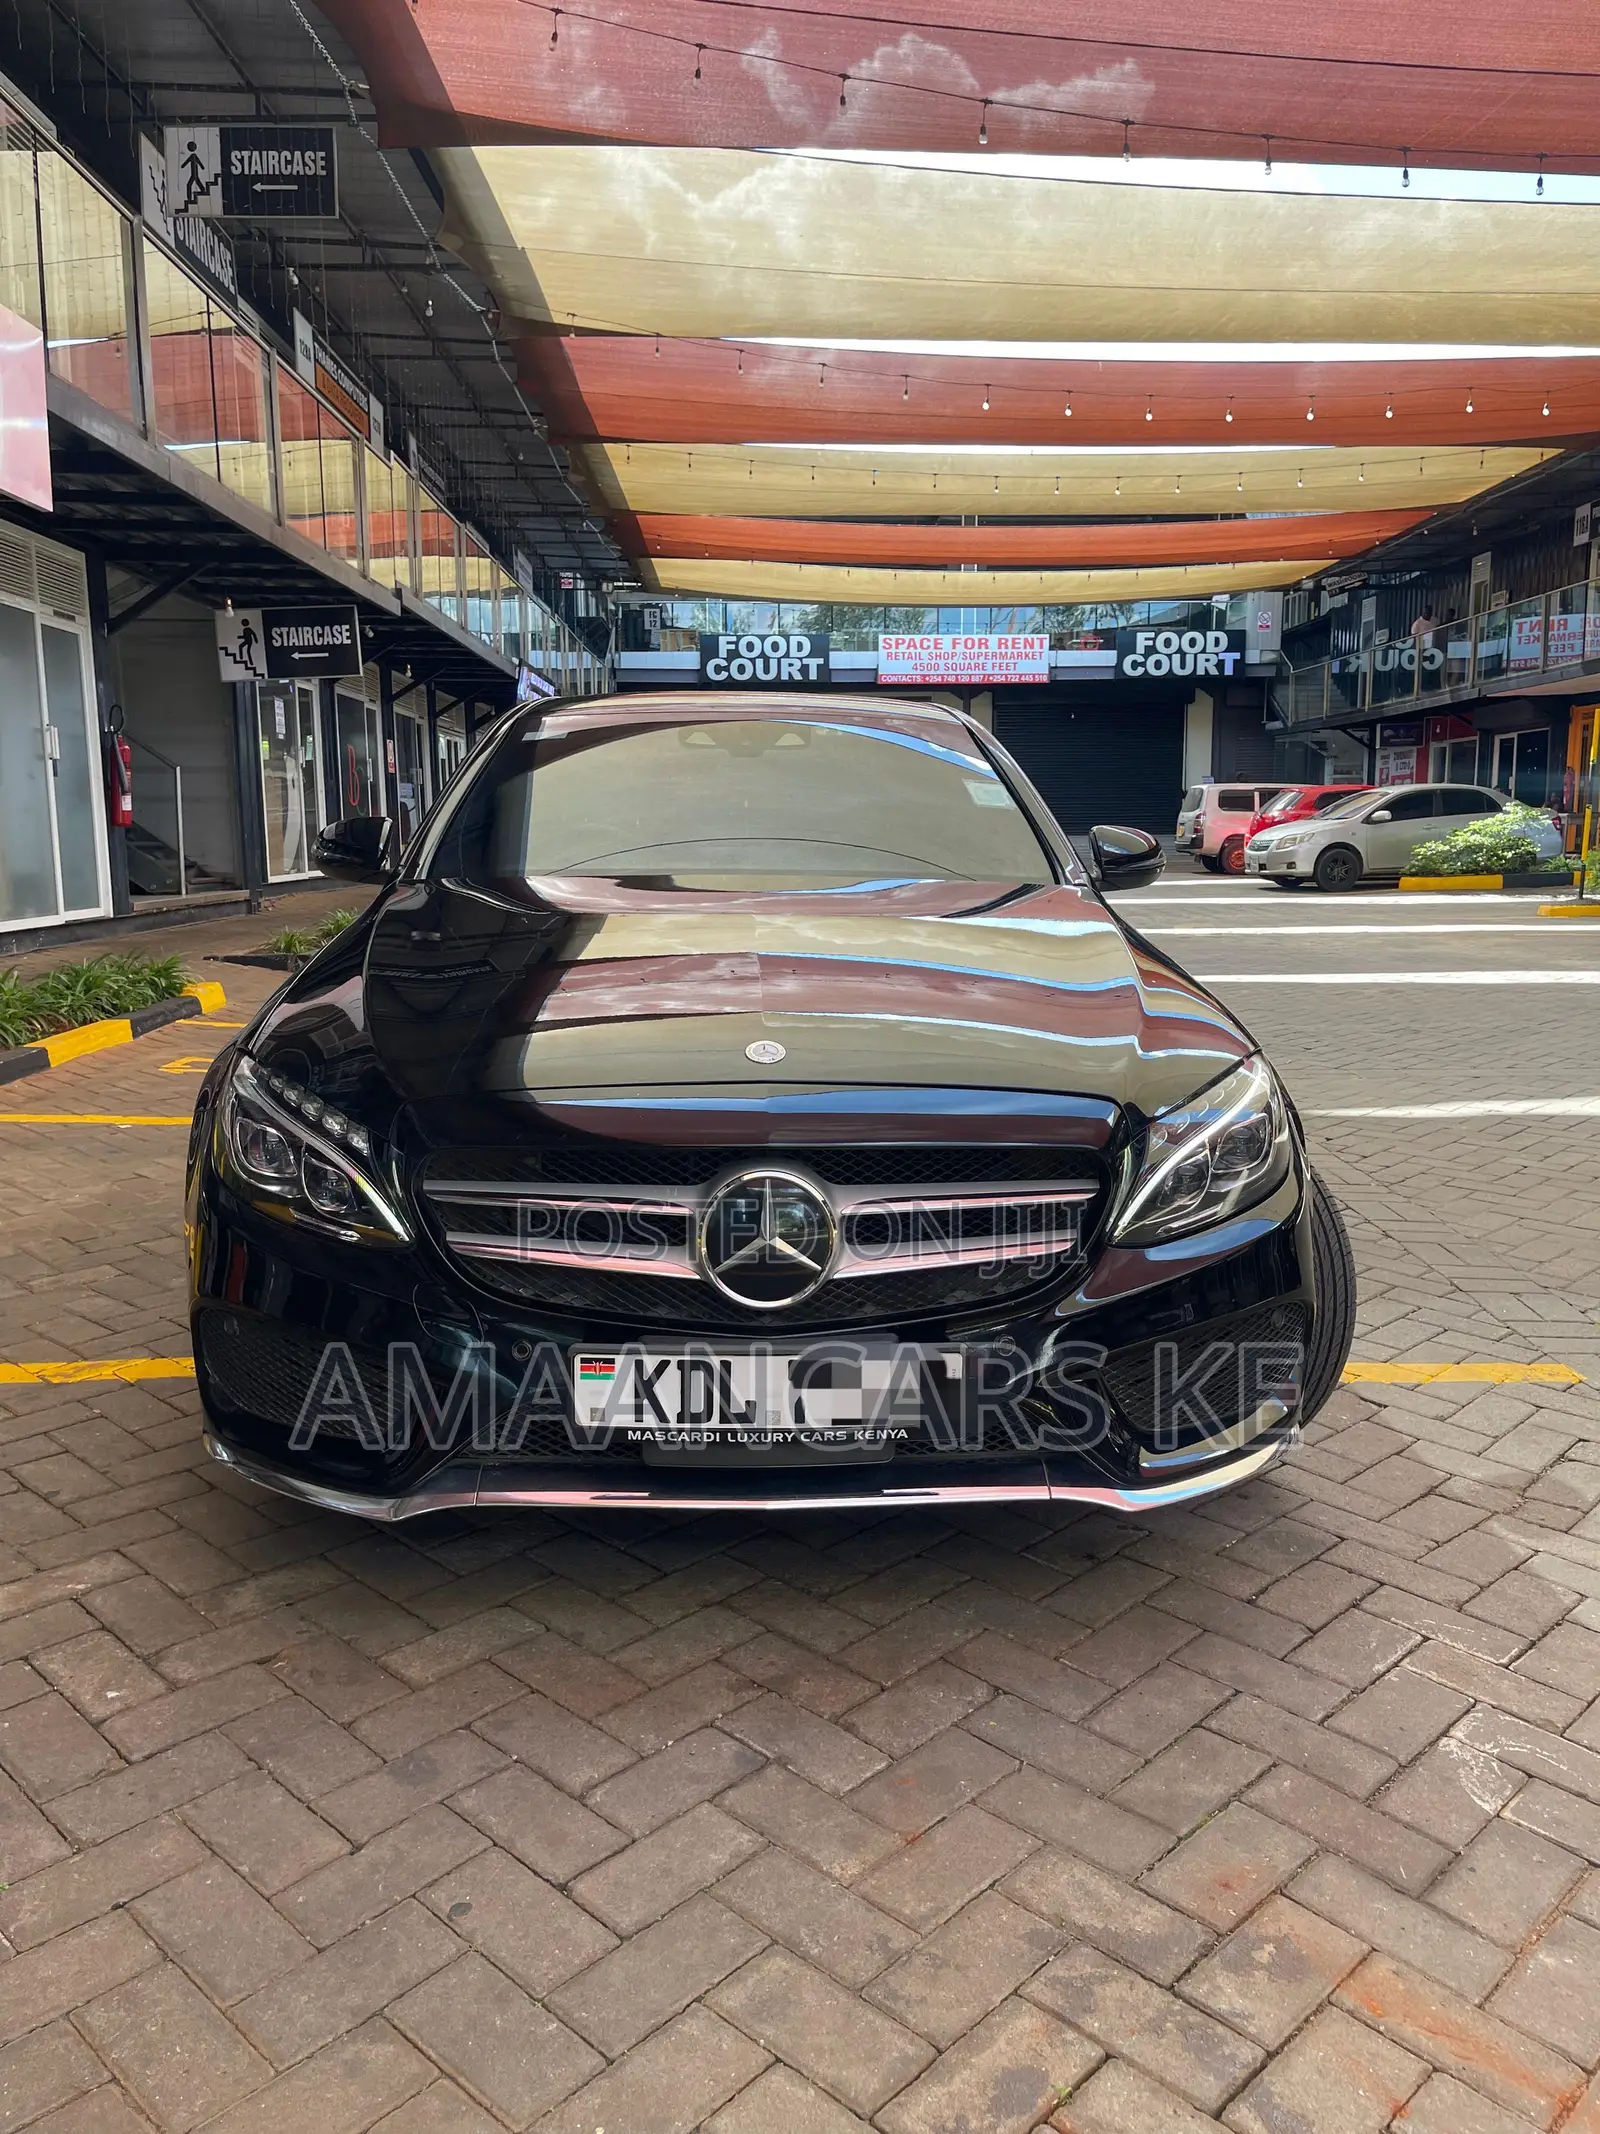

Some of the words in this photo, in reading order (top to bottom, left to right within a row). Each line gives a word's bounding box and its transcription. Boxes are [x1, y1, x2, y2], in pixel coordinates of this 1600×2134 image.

[230, 151, 327, 176] STAIRCASE
[176, 217, 236, 296] STAIRCASE
[648, 619, 658, 628] 12
[271, 625, 352, 647] STAIRCASE
[718, 635, 811, 658] FOOD
[882, 637, 944, 650] SPACE
[951, 637, 990, 650] FOR
[997, 637, 1048, 650] RENT
[1136, 631, 1229, 654] FOOD
[886, 651, 924, 661] RETAIL
[927, 651, 1045, 661] SHOP/SUPERMARKET
[912, 662, 940, 672] 4500
[943, 662, 988, 672] SQUARE
[991, 662, 1019, 671] FEET
[1122, 652, 1241, 677] COURT
[706, 657, 824, 681] COURT
[881, 675, 924, 683] CONTACTS:
[925, 675, 942, 683] +254
[989, 675, 1006, 683] +254
[634, 1359, 757, 1425] KDL
[627, 1430, 720, 1443] MASCARDI
[728, 1431, 796, 1443] LUXURY
[801, 1431, 847, 1442] CARS
[854, 1428, 909, 1440] KENYA
